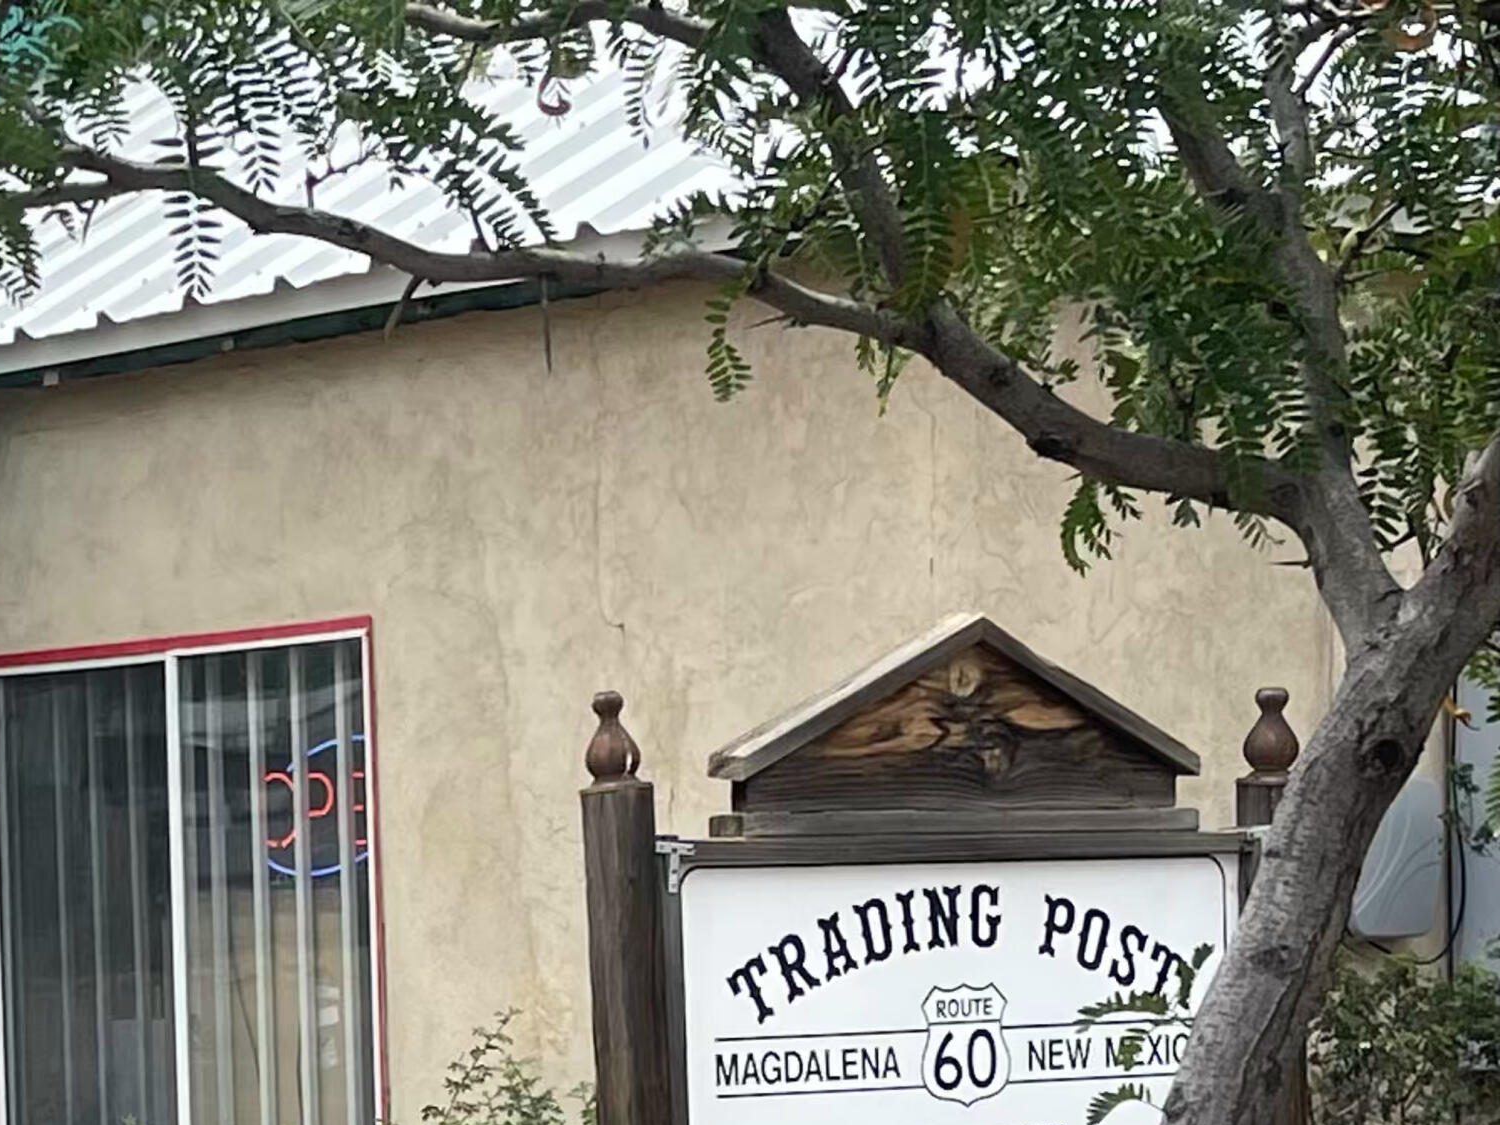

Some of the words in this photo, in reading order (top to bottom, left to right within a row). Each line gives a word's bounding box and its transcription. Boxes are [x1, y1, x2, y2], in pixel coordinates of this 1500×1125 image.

[726, 883, 1002, 1024] TRADING
[1038, 893, 1193, 997] POST
[935, 997, 994, 1019] ROUTE
[714, 1045, 901, 1087] MAGDALENA
[1027, 1037, 1092, 1072] NEW
[1105, 1032, 1191, 1070] MEXIC
[933, 1028, 998, 1091] 60
